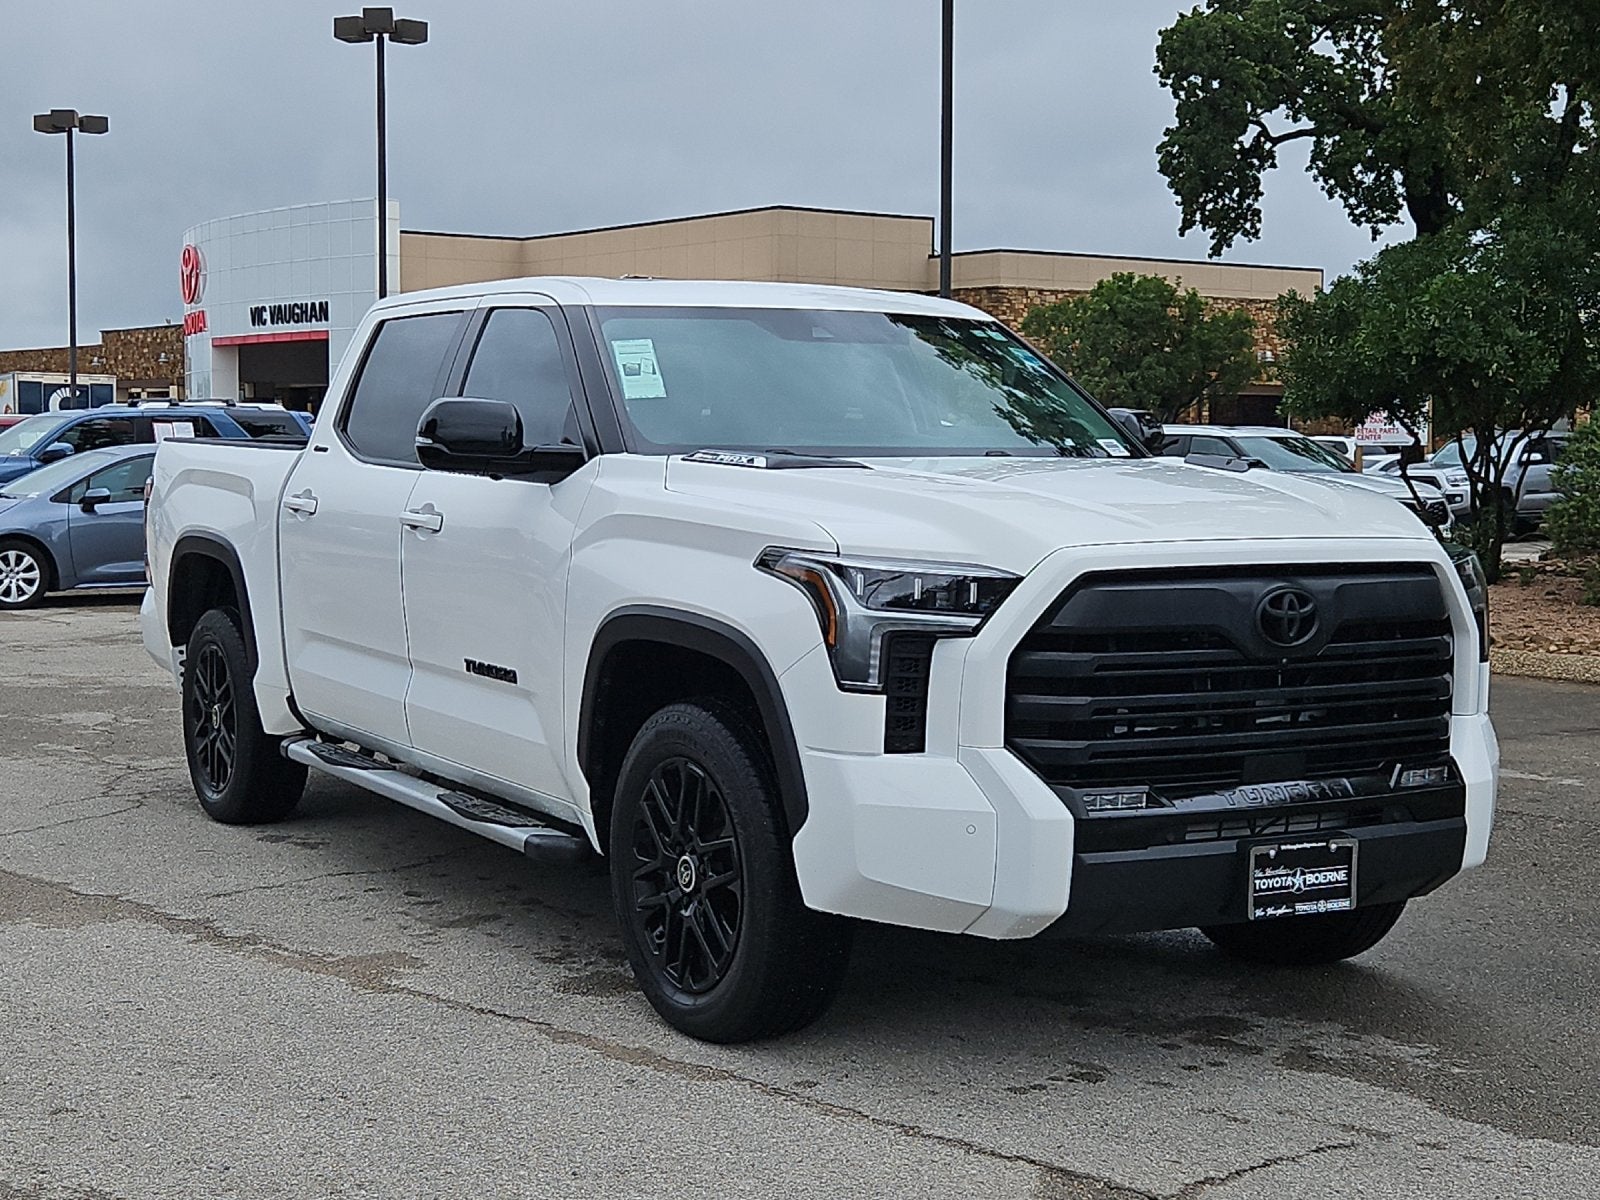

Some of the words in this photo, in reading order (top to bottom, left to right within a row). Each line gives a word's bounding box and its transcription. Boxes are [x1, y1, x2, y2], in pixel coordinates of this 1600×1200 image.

[250, 305, 268, 327] VIC
[268, 301, 329, 325] VAUGHAN
[1215, 778, 1355, 806] TUNDRA
[1254, 877, 1293, 890] TOYOTA
[1306, 870, 1348, 885] BOERNE
